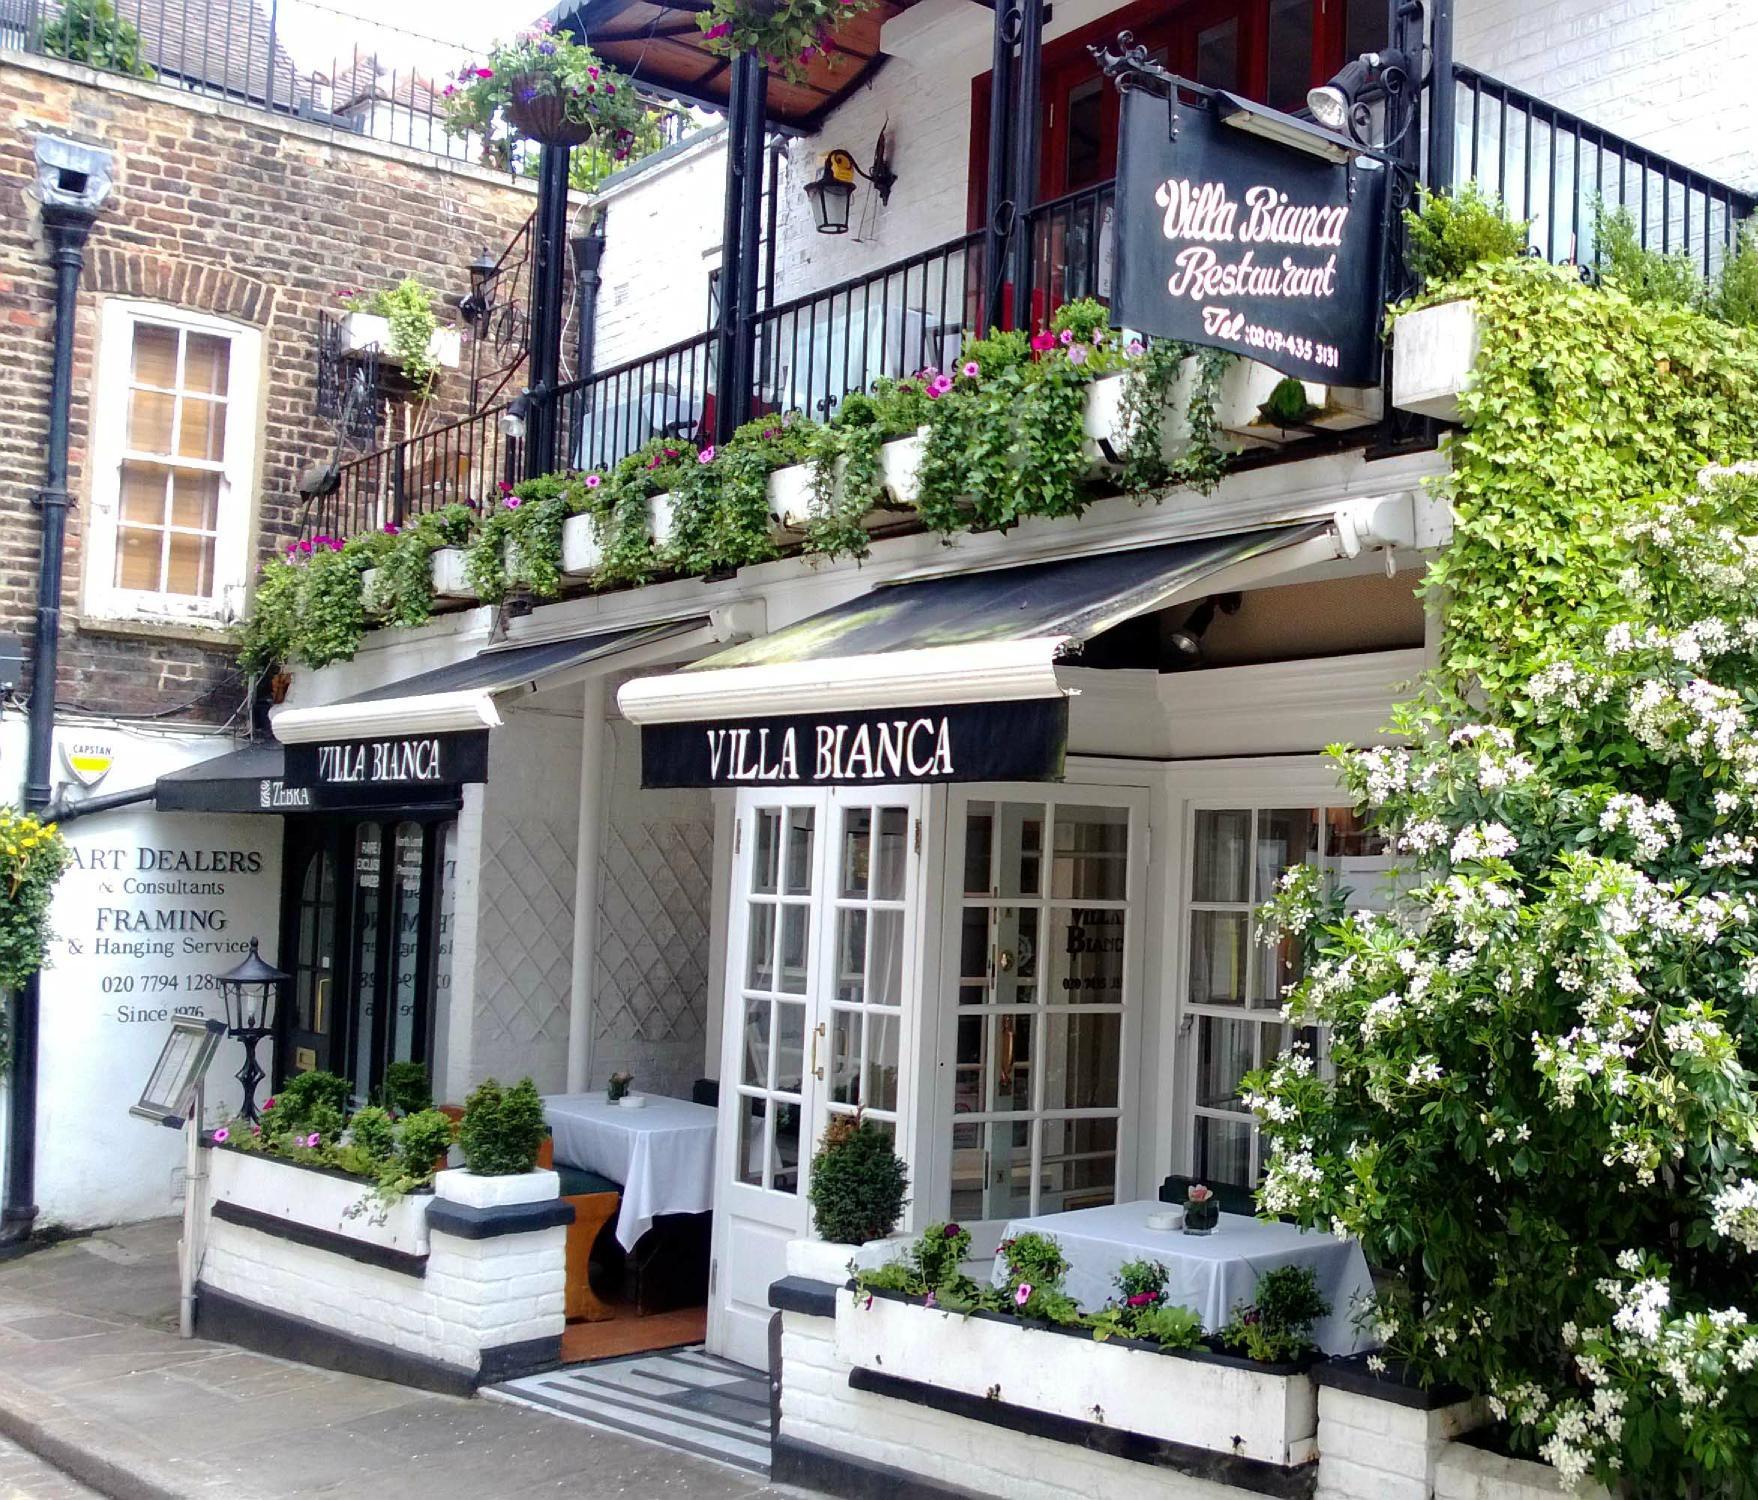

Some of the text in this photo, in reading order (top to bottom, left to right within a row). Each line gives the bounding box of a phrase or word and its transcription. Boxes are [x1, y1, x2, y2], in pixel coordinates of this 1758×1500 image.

[1155, 178, 1349, 247] Villa Bianca
[1168, 247, 1336, 300] Restaurant
[1202, 306, 1245, 342] Tel
[1315, 344, 1340, 368] 3131
[73, 744, 111, 755] CAPSTAN
[318, 740, 441, 782] VILLA BIANCA
[707, 717, 954, 780] VILLA BIANCA
[272, 781, 310, 806] ZEBRA
[65, 847, 262, 873] ART DEALERS
[124, 878, 225, 895] Consultants
[96, 908, 229, 931] FRAMING
[68, 939, 84, 955] &
[95, 938, 175, 958] Hanging
[102, 976, 135, 993] 020
[140, 975, 178, 992] 7794
[118, 1005, 167, 1023] Since
